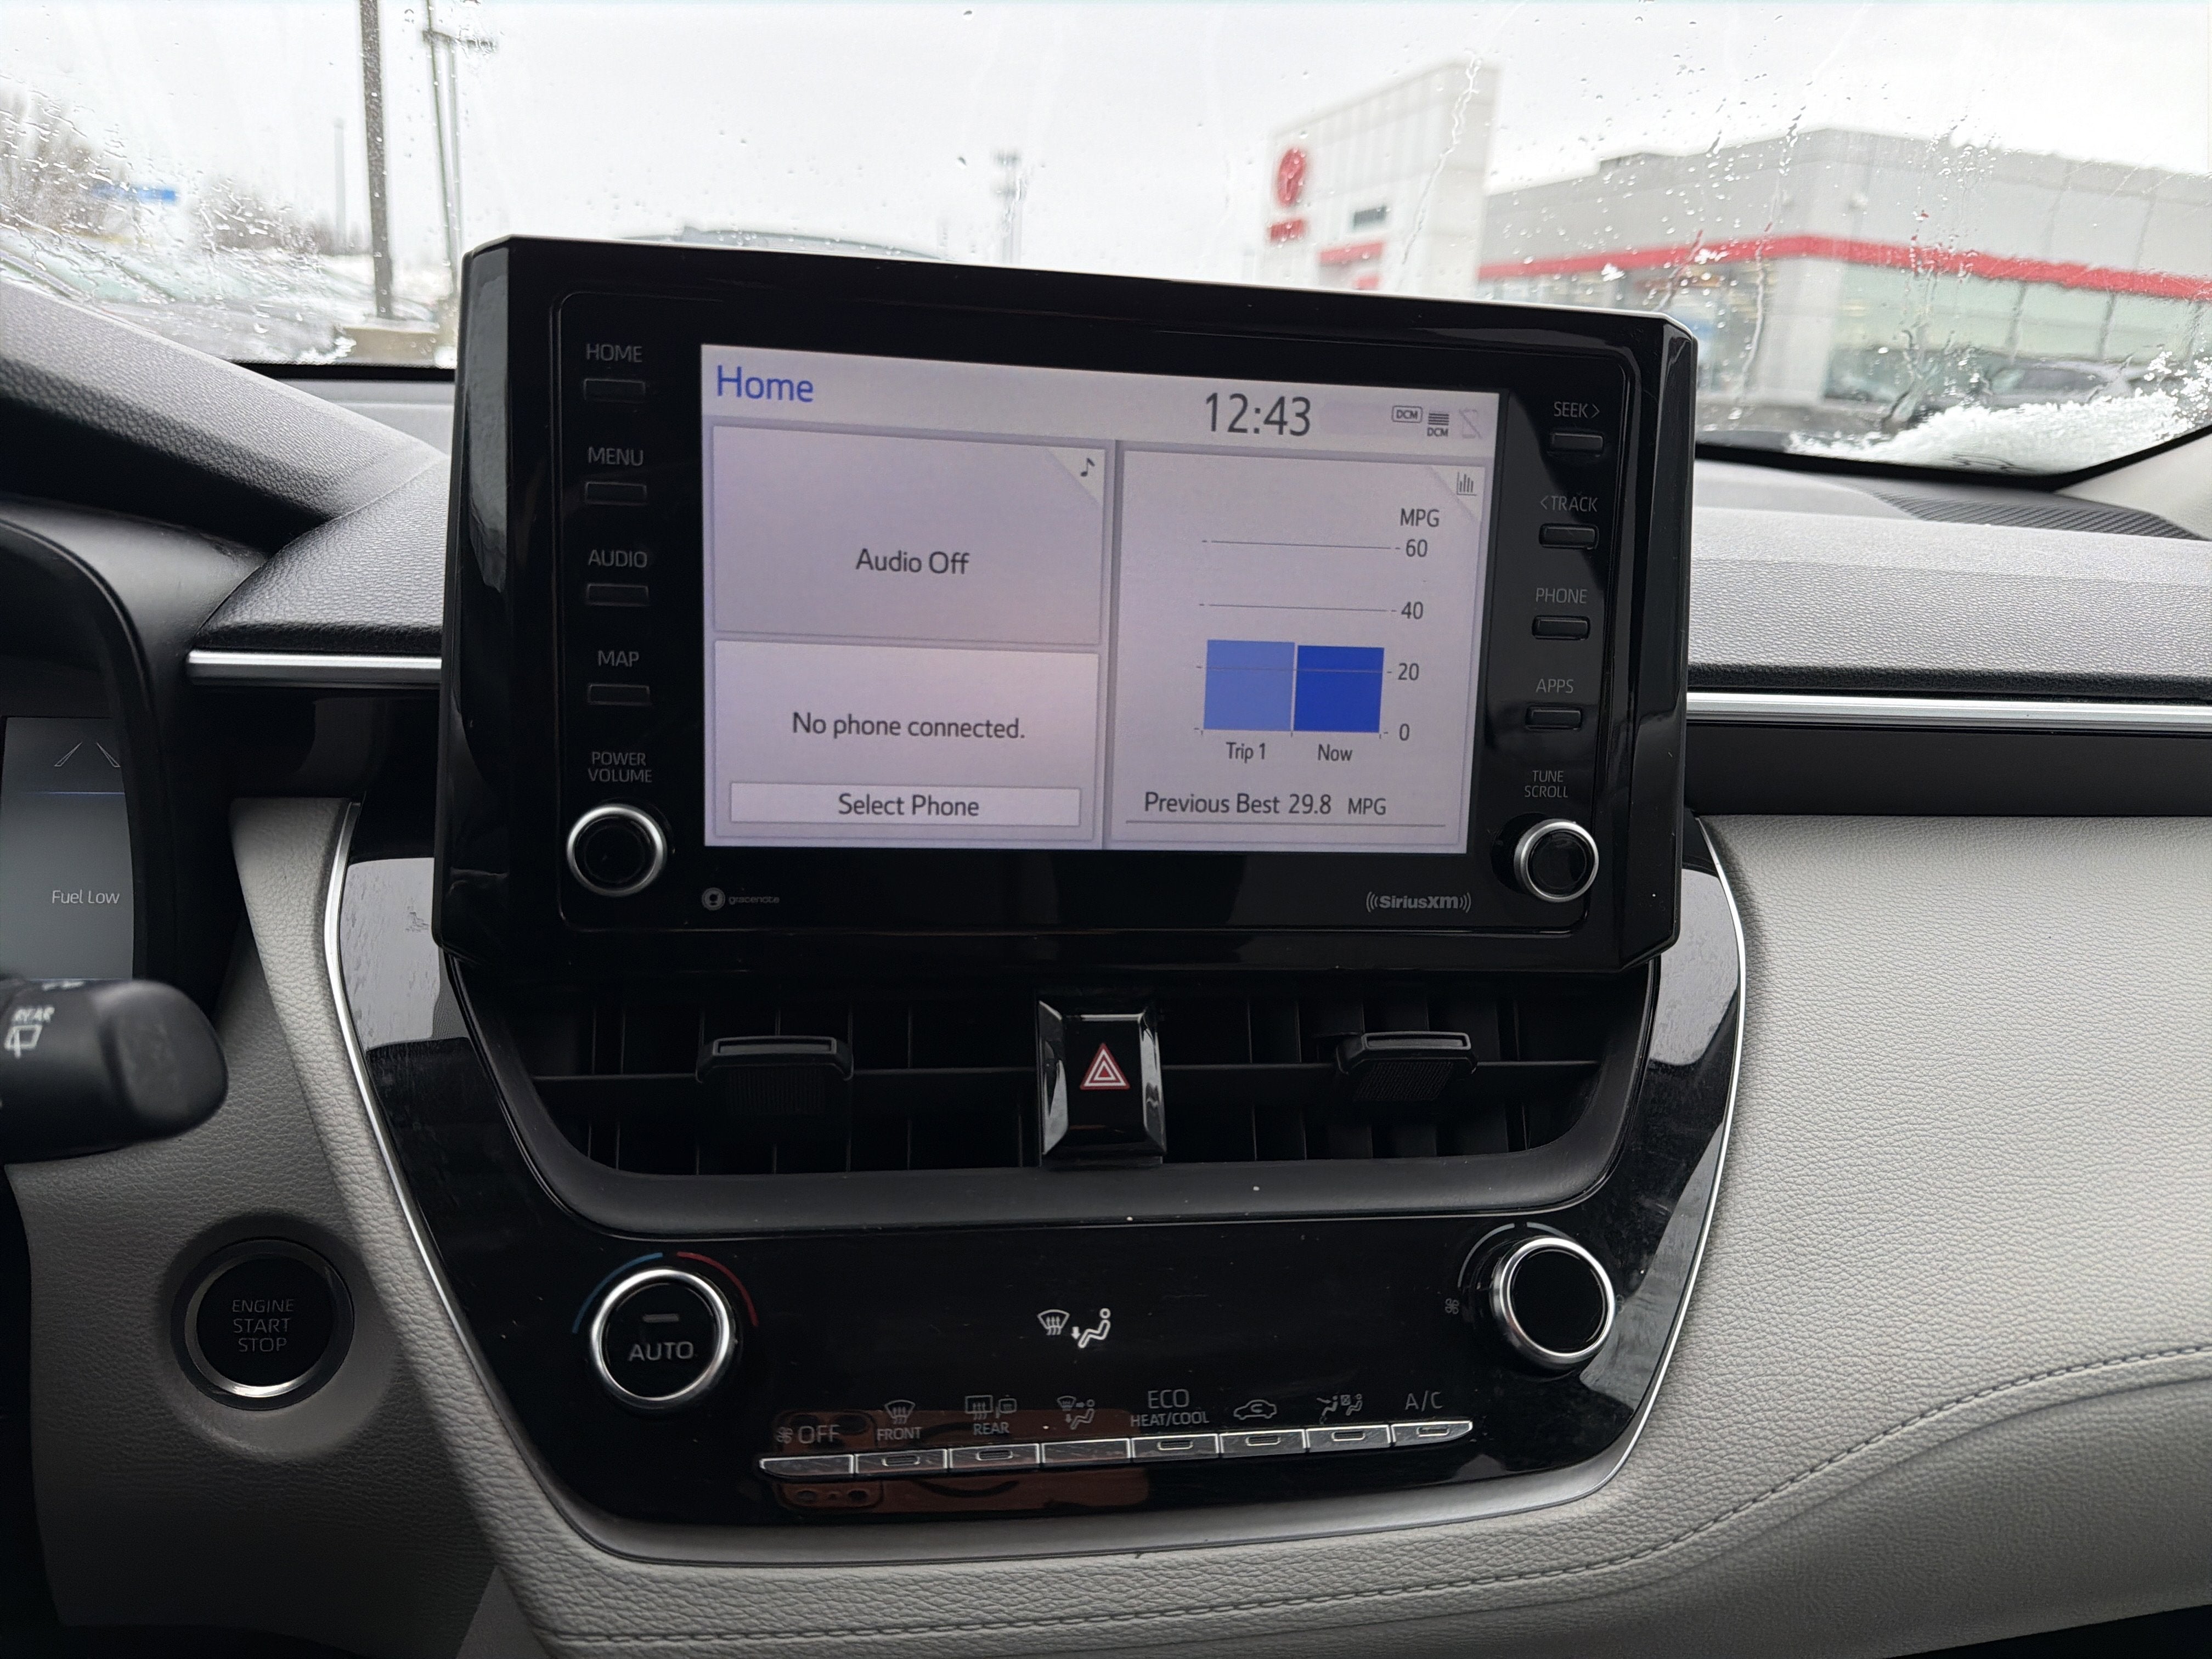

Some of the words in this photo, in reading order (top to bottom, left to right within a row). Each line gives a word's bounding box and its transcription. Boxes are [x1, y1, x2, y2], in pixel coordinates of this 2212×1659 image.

[586, 343, 642, 363] HOME
[716, 365, 814, 402] Home
[1205, 392, 1312, 437] 12:43
[1396, 409, 1419, 420] DCM
[1553, 401, 1589, 419] SEEK
[1426, 427, 1449, 437] DCM
[588, 446, 644, 466] MENU
[1550, 496, 1598, 512] TRACK
[1400, 507, 1441, 527] MPG
[1405, 539, 1428, 557] 60
[588, 549, 648, 568] AUDIO
[855, 548, 923, 573] Audio
[929, 551, 970, 574] Off
[1536, 588, 1588, 605] PHONE
[1401, 601, 1424, 619] 40
[597, 649, 640, 668] MAP
[1397, 663, 1420, 680] 20
[1536, 678, 1575, 694] APPS
[792, 712, 827, 734] No
[833, 713, 901, 740] phone
[907, 718, 1025, 739] connected.
[1398, 723, 1410, 742] 0
[591, 751, 647, 766] POWER
[1226, 742, 1254, 763] Trip
[1259, 742, 1266, 760] 1
[1317, 744, 1353, 761] Now
[588, 769, 653, 783] VOLUME
[1532, 770, 1564, 783] TUNE
[1524, 785, 1568, 799] SCROLL
[838, 793, 905, 815] Select
[911, 794, 980, 816] Phone
[1144, 791, 1230, 814] Previous
[1236, 793, 1280, 814] Best
[1288, 793, 1332, 815] 29.8
[1347, 798, 1387, 815] MPG
[52, 889, 83, 905] Fuel
[88, 890, 120, 905] Low
[728, 894, 780, 905] gracenote
[232, 1300, 294, 1313] ENGINE
[233, 1318, 290, 1333] START
[238, 1338, 287, 1352] STOP
[629, 1341, 695, 1362] AUTO
[1147, 1389, 1190, 1409] ECO
[1404, 1390, 1444, 1412] A/C
[1130, 1411, 1210, 1427] HEAT/COOL
[798, 1424, 840, 1444] OFF
[877, 1426, 922, 1441] FRONT
[973, 1422, 1010, 1436] REAR
